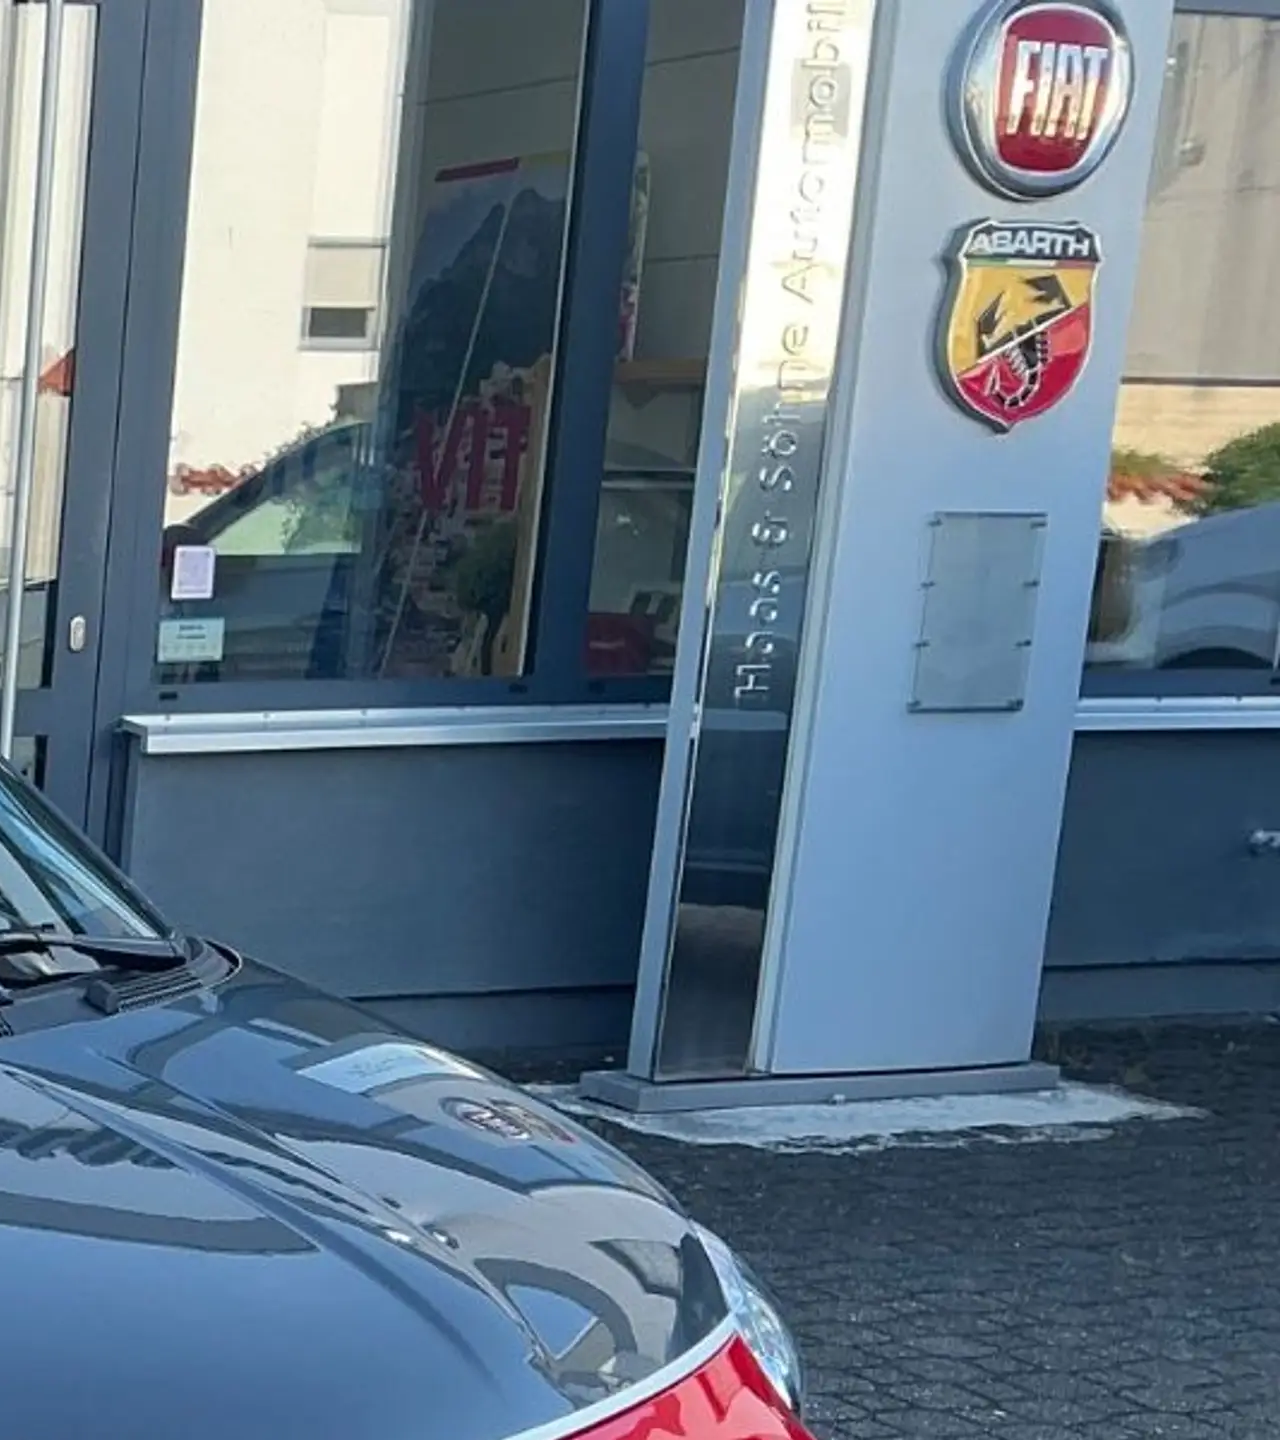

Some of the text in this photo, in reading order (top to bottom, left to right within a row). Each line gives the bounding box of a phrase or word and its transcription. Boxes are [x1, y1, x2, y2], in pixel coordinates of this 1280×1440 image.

[1006, 40, 1109, 141] FIAT
[970, 230, 1090, 257] ABARTH
[733, 570, 781, 699] Haas
